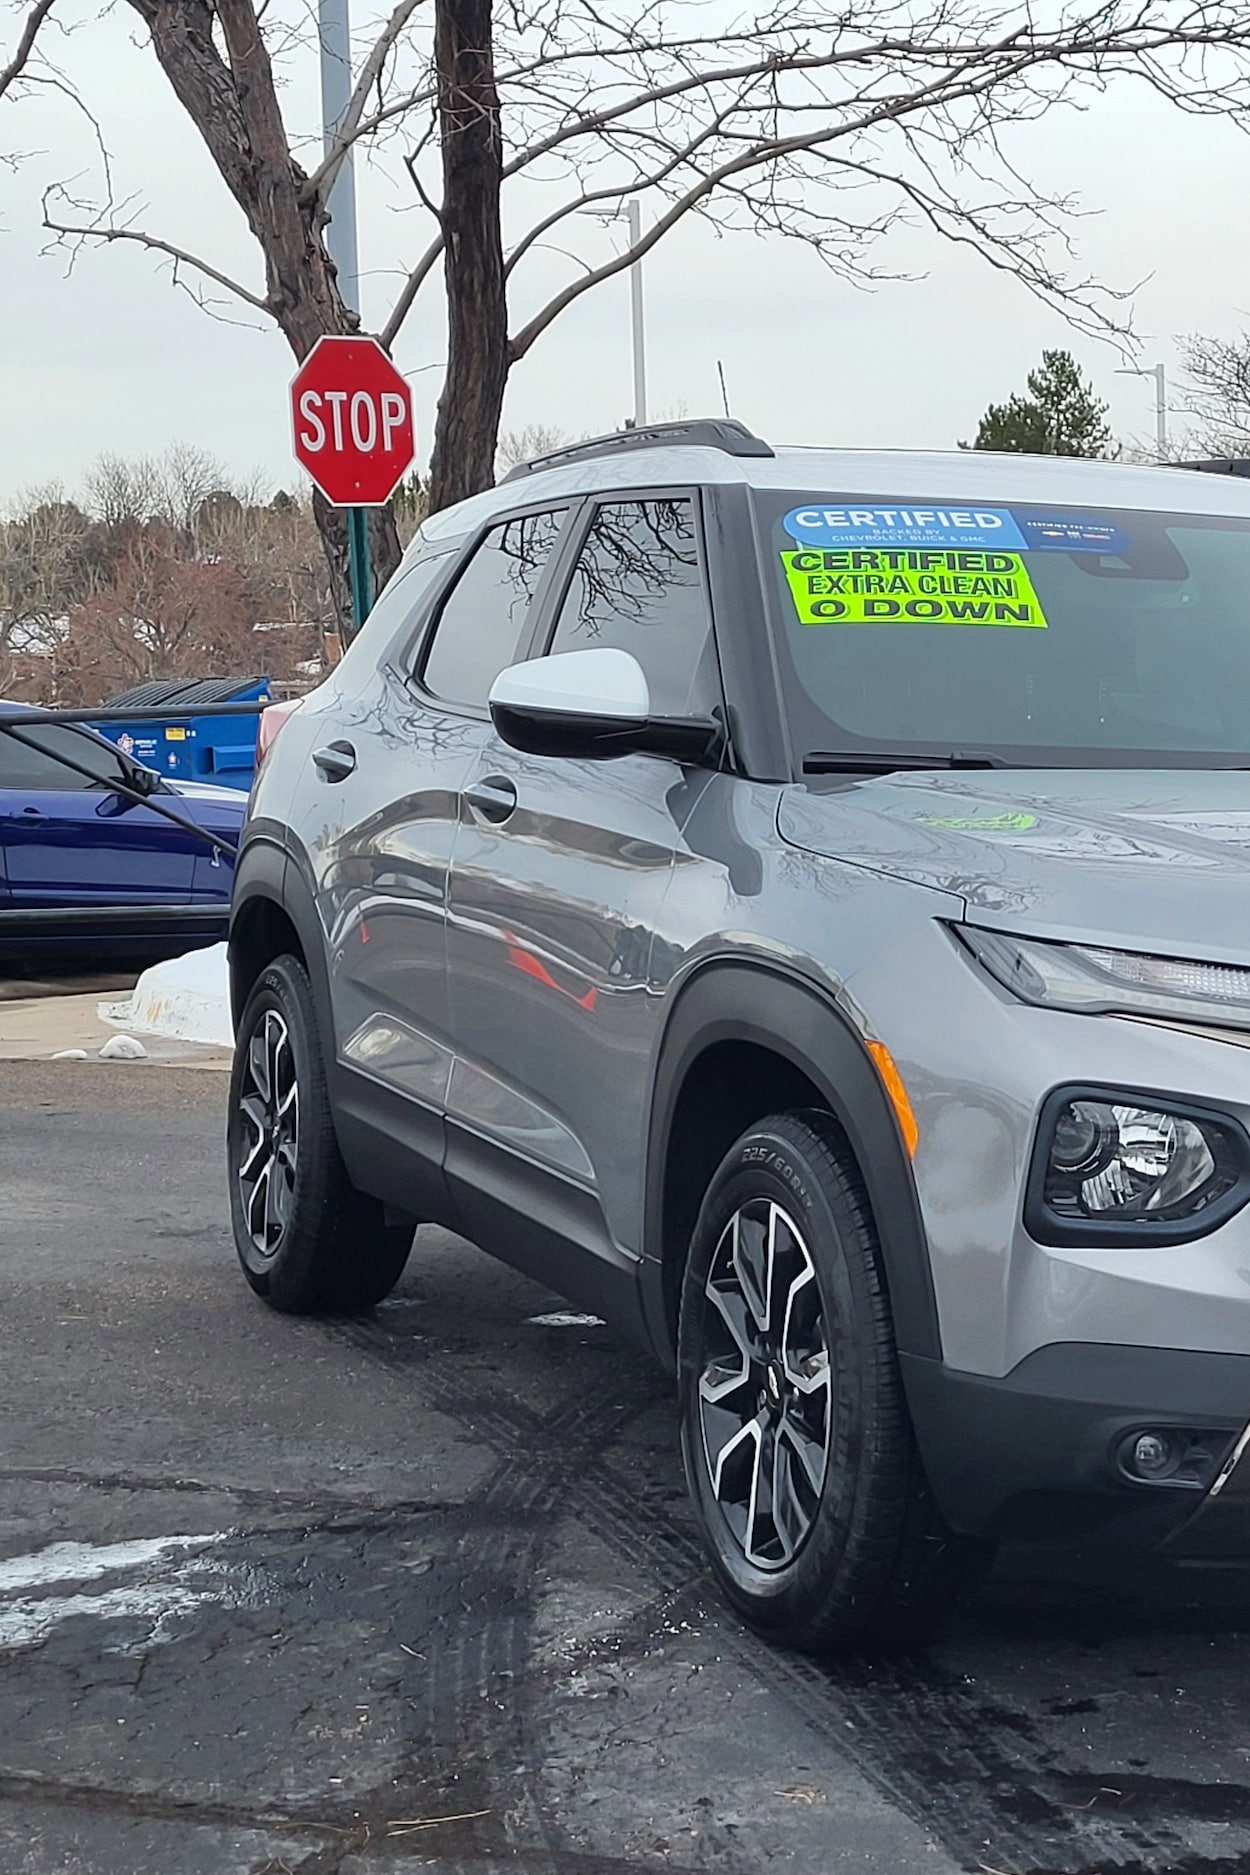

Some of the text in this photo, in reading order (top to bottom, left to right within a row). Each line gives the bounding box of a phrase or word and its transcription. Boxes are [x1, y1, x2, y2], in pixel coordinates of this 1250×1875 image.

[300, 390, 406, 452] STOP
[795, 510, 1002, 529] CERTIFIED
[872, 528, 940, 536] BACKED BY
[909, 535, 946, 543] BUICK
[791, 551, 1015, 573] CERTIFIED
[807, 575, 1014, 597] EXTRA CLEAN
[863, 599, 1030, 621] DOWN
